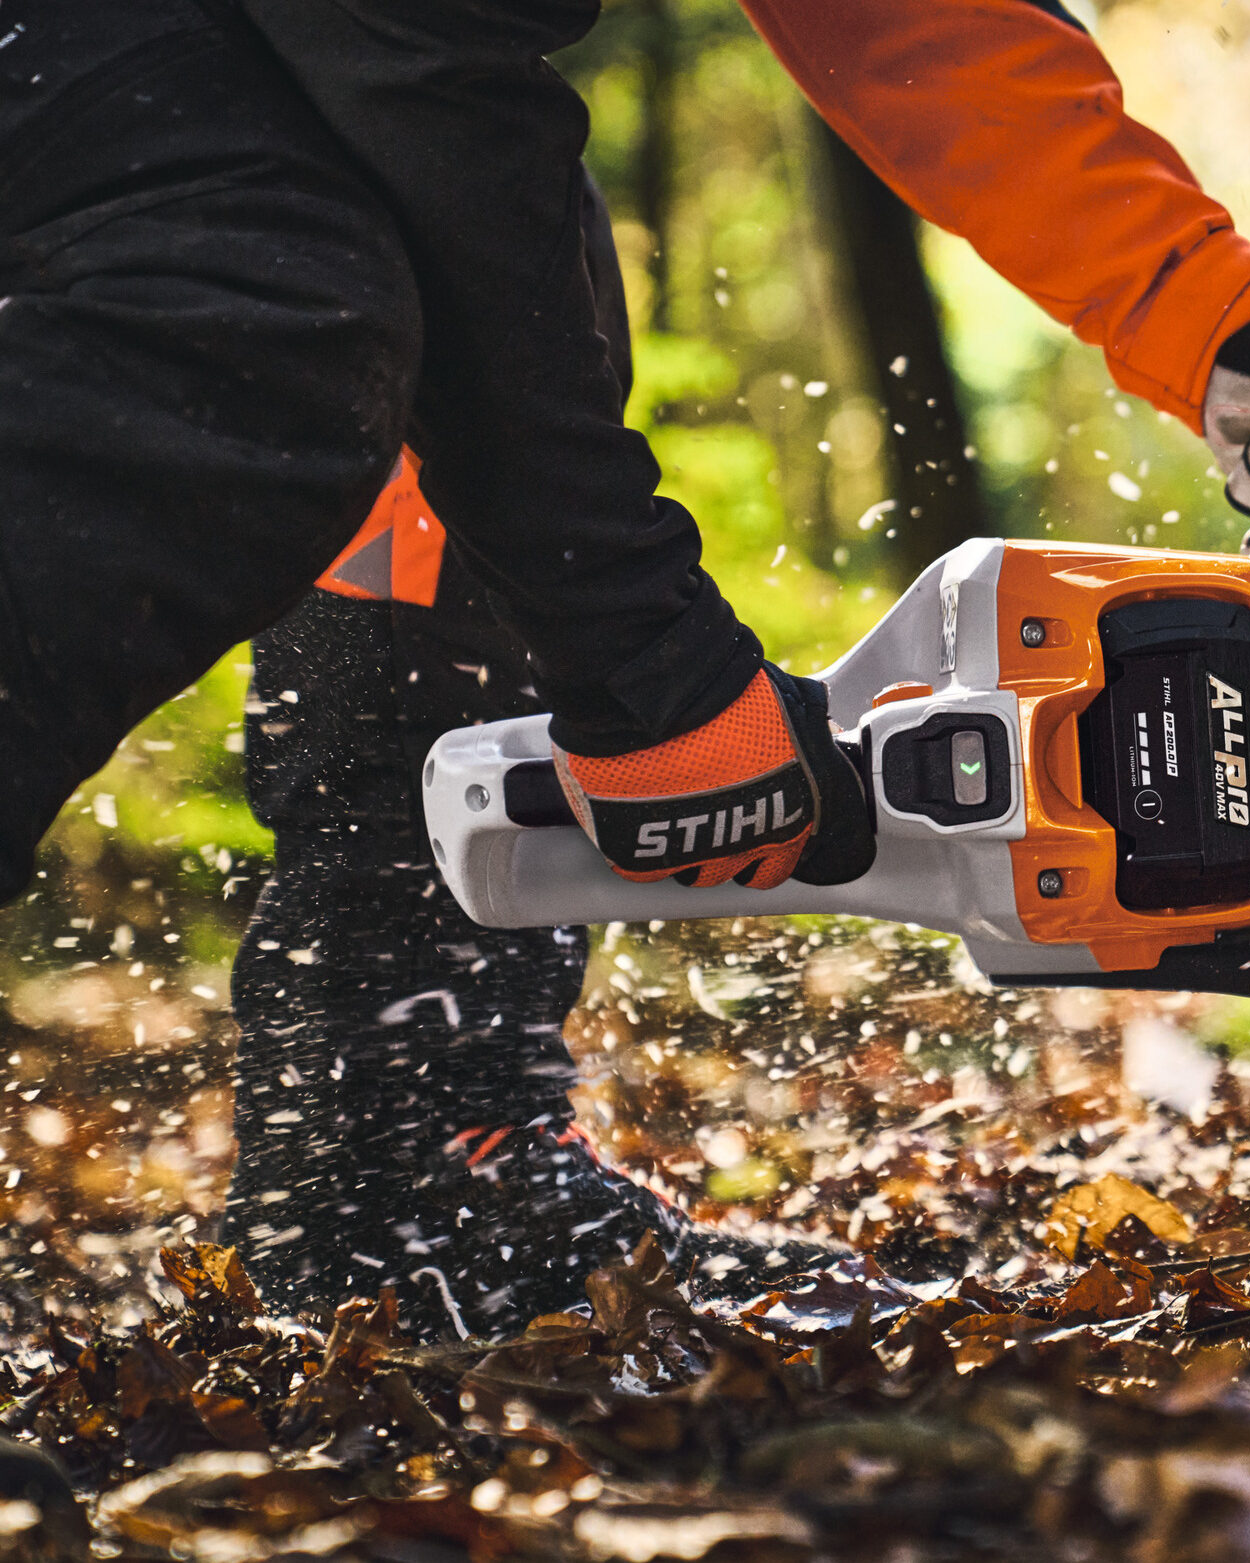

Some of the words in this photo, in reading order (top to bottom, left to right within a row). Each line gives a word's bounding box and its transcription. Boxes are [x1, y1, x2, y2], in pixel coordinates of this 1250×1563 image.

[1163, 676, 1171, 706] STIHL
[1165, 714, 1173, 728] AP
[1166, 730, 1175, 761] 200.0
[1129, 746, 1137, 787] LITHIUM-ION
[1168, 765, 1176, 774] P
[1214, 763, 1224, 790] 40V
[1215, 791, 1227, 820] MAX
[634, 790, 803, 858] STIHL
